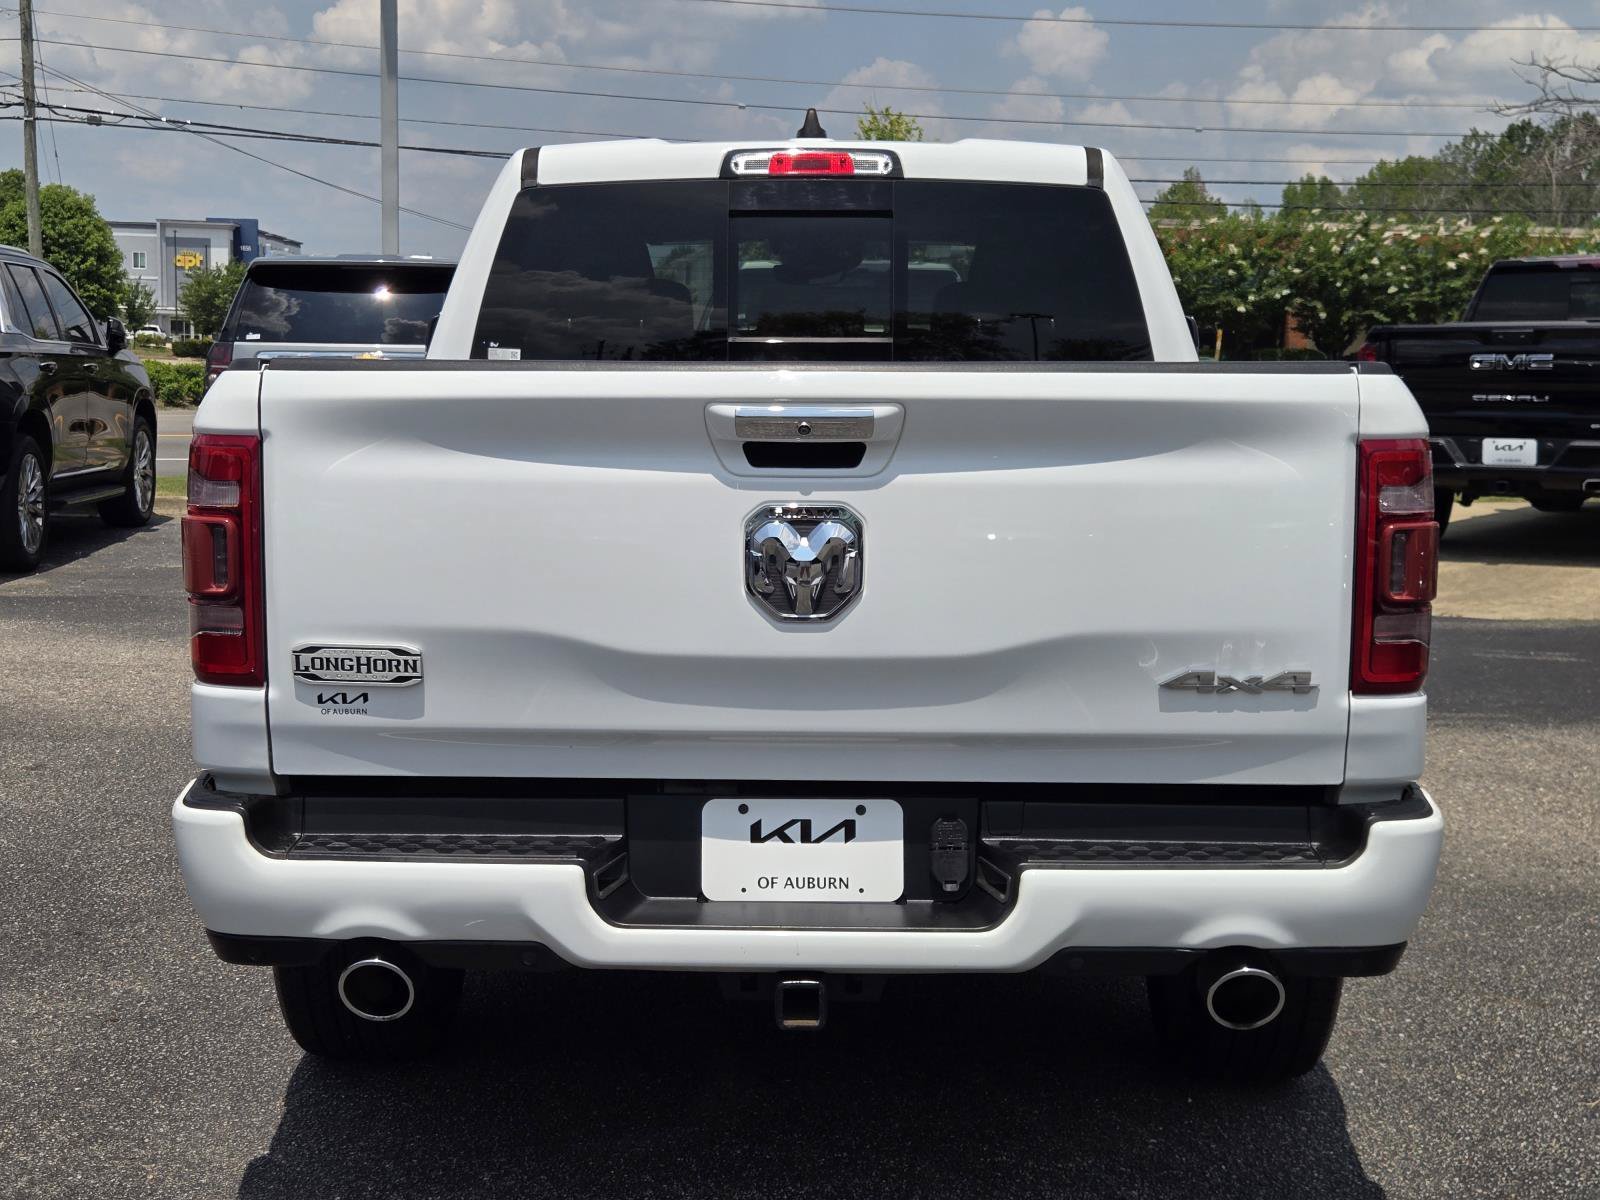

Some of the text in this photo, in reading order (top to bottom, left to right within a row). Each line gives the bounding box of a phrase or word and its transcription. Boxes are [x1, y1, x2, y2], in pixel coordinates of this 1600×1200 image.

[1470, 353, 1554, 370] GMC
[317, 692, 369, 704] KIA
[750, 818, 856, 844] KIA
[757, 877, 849, 889] OF AUBURN
